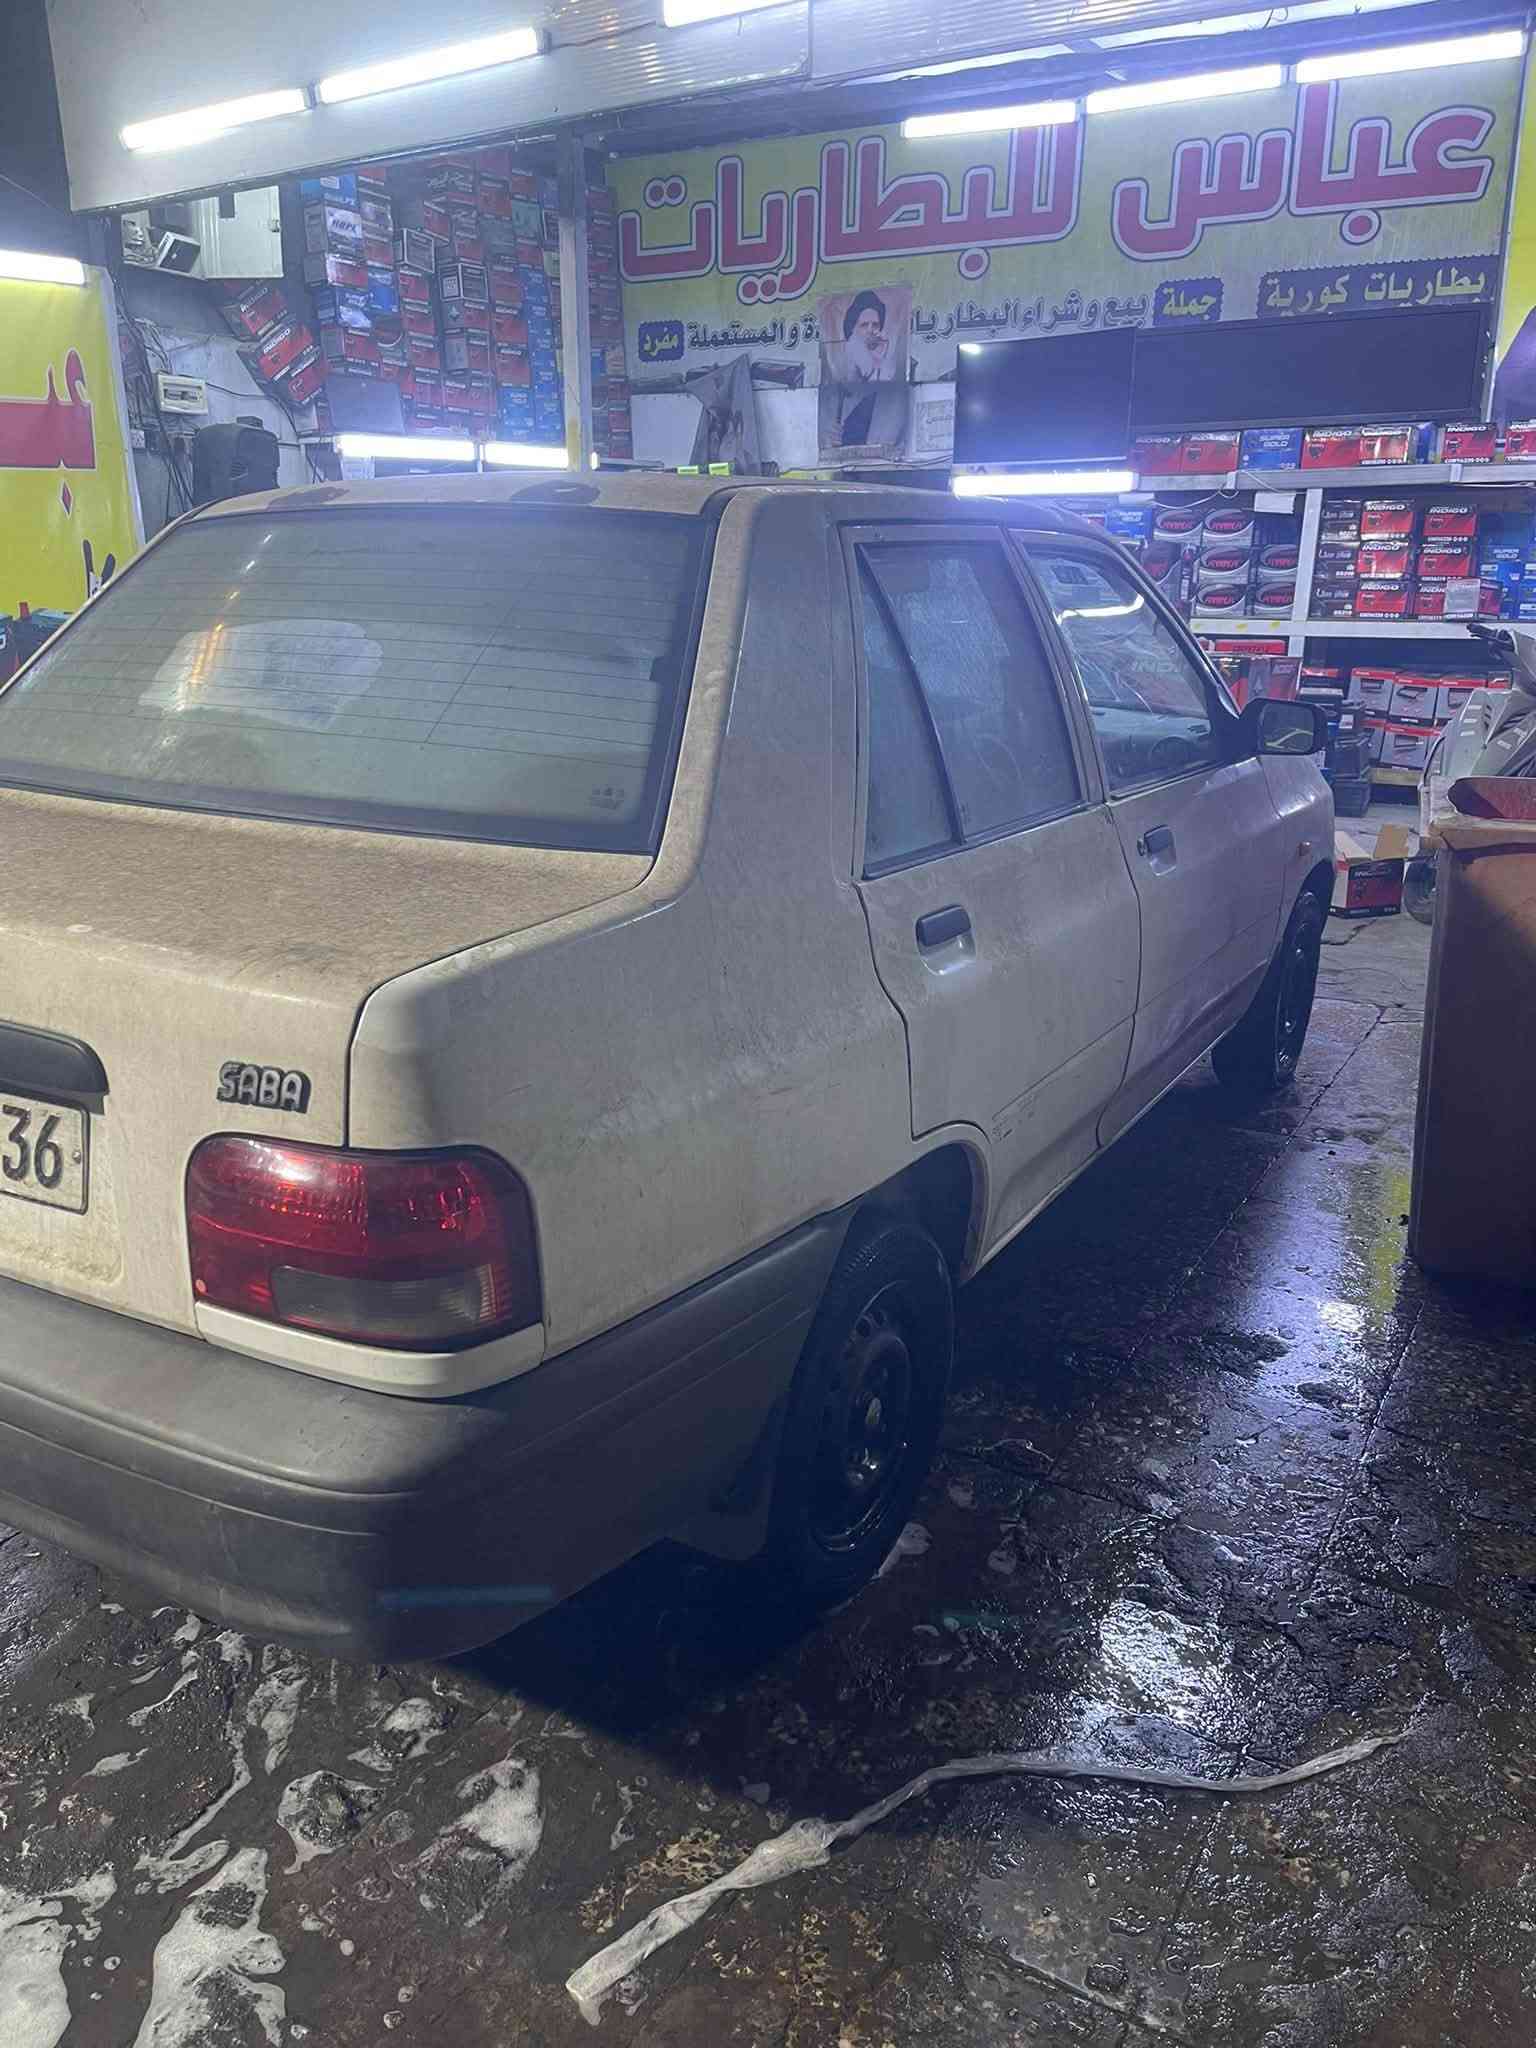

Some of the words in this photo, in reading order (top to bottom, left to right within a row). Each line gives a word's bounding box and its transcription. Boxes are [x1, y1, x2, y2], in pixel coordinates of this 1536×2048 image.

[1112, 79, 1494, 261] عباس
[618, 120, 1086, 304] للبطاريات
[1161, 286, 1217, 321] جملة
[1266, 273, 1350, 317] كورية
[1364, 267, 1486, 307] بطاريات
[911, 299, 1017, 342] البطاريا
[1103, 294, 1148, 328] بيع
[644, 327, 679, 357] مفرد
[1361, 543, 1400, 551] INDIGO
[1360, 582, 1399, 591] INDIGO
[217, 1061, 311, 1114] SABA
[1, 1103, 64, 1189] 36
